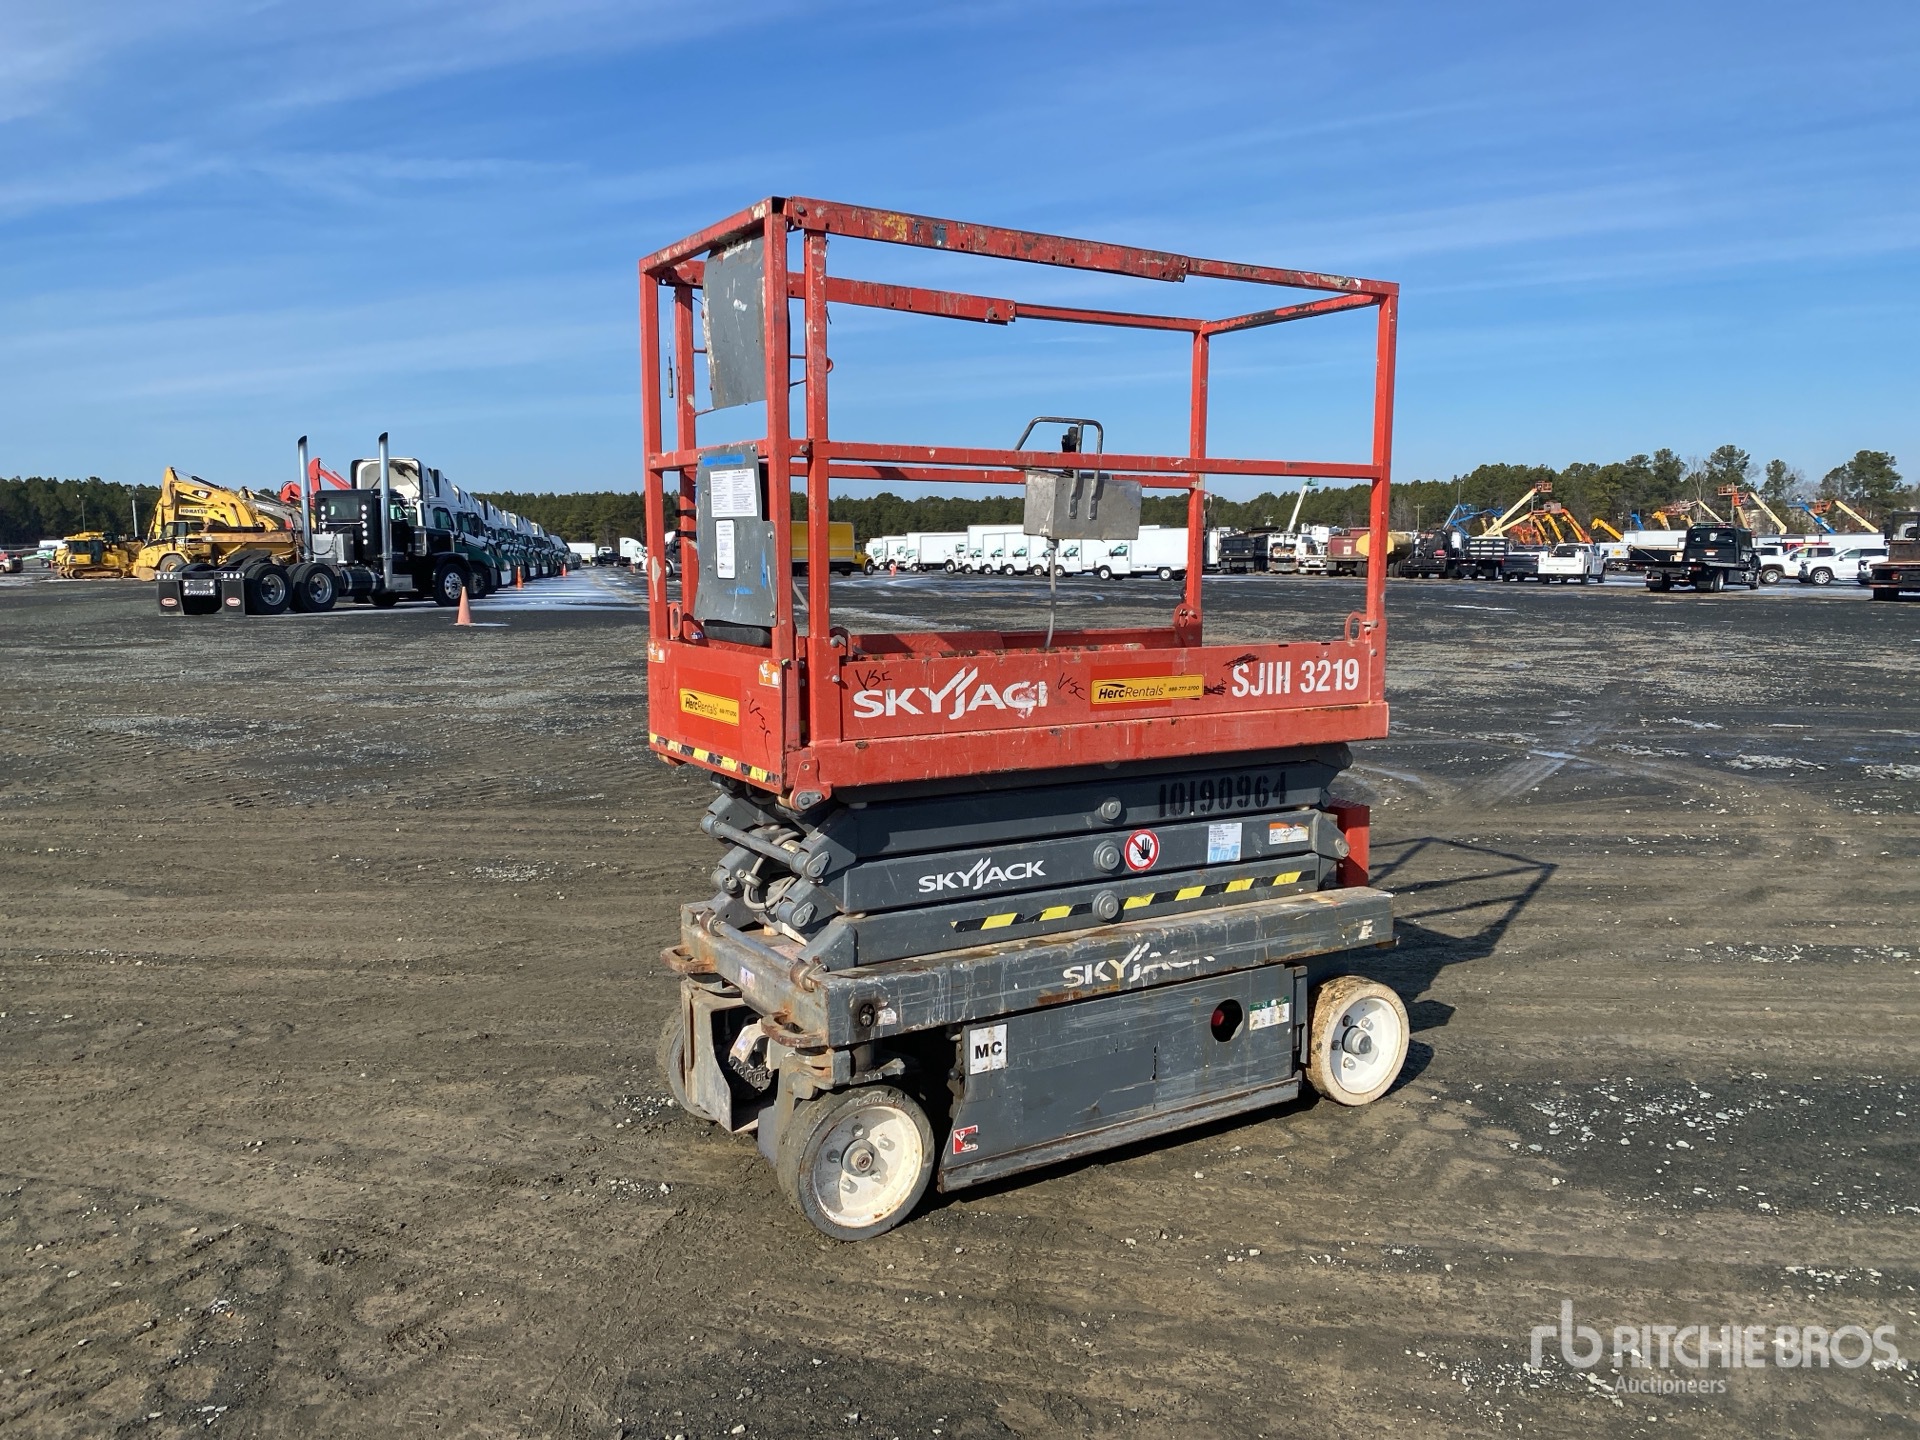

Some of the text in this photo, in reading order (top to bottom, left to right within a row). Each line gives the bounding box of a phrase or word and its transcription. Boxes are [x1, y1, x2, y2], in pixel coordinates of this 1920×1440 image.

[1300, 659, 1359, 693] 3219
[1159, 772, 1287, 817] 10190964
[918, 857, 1046, 892] SKYJACK
[975, 1041, 1002, 1059] MC
